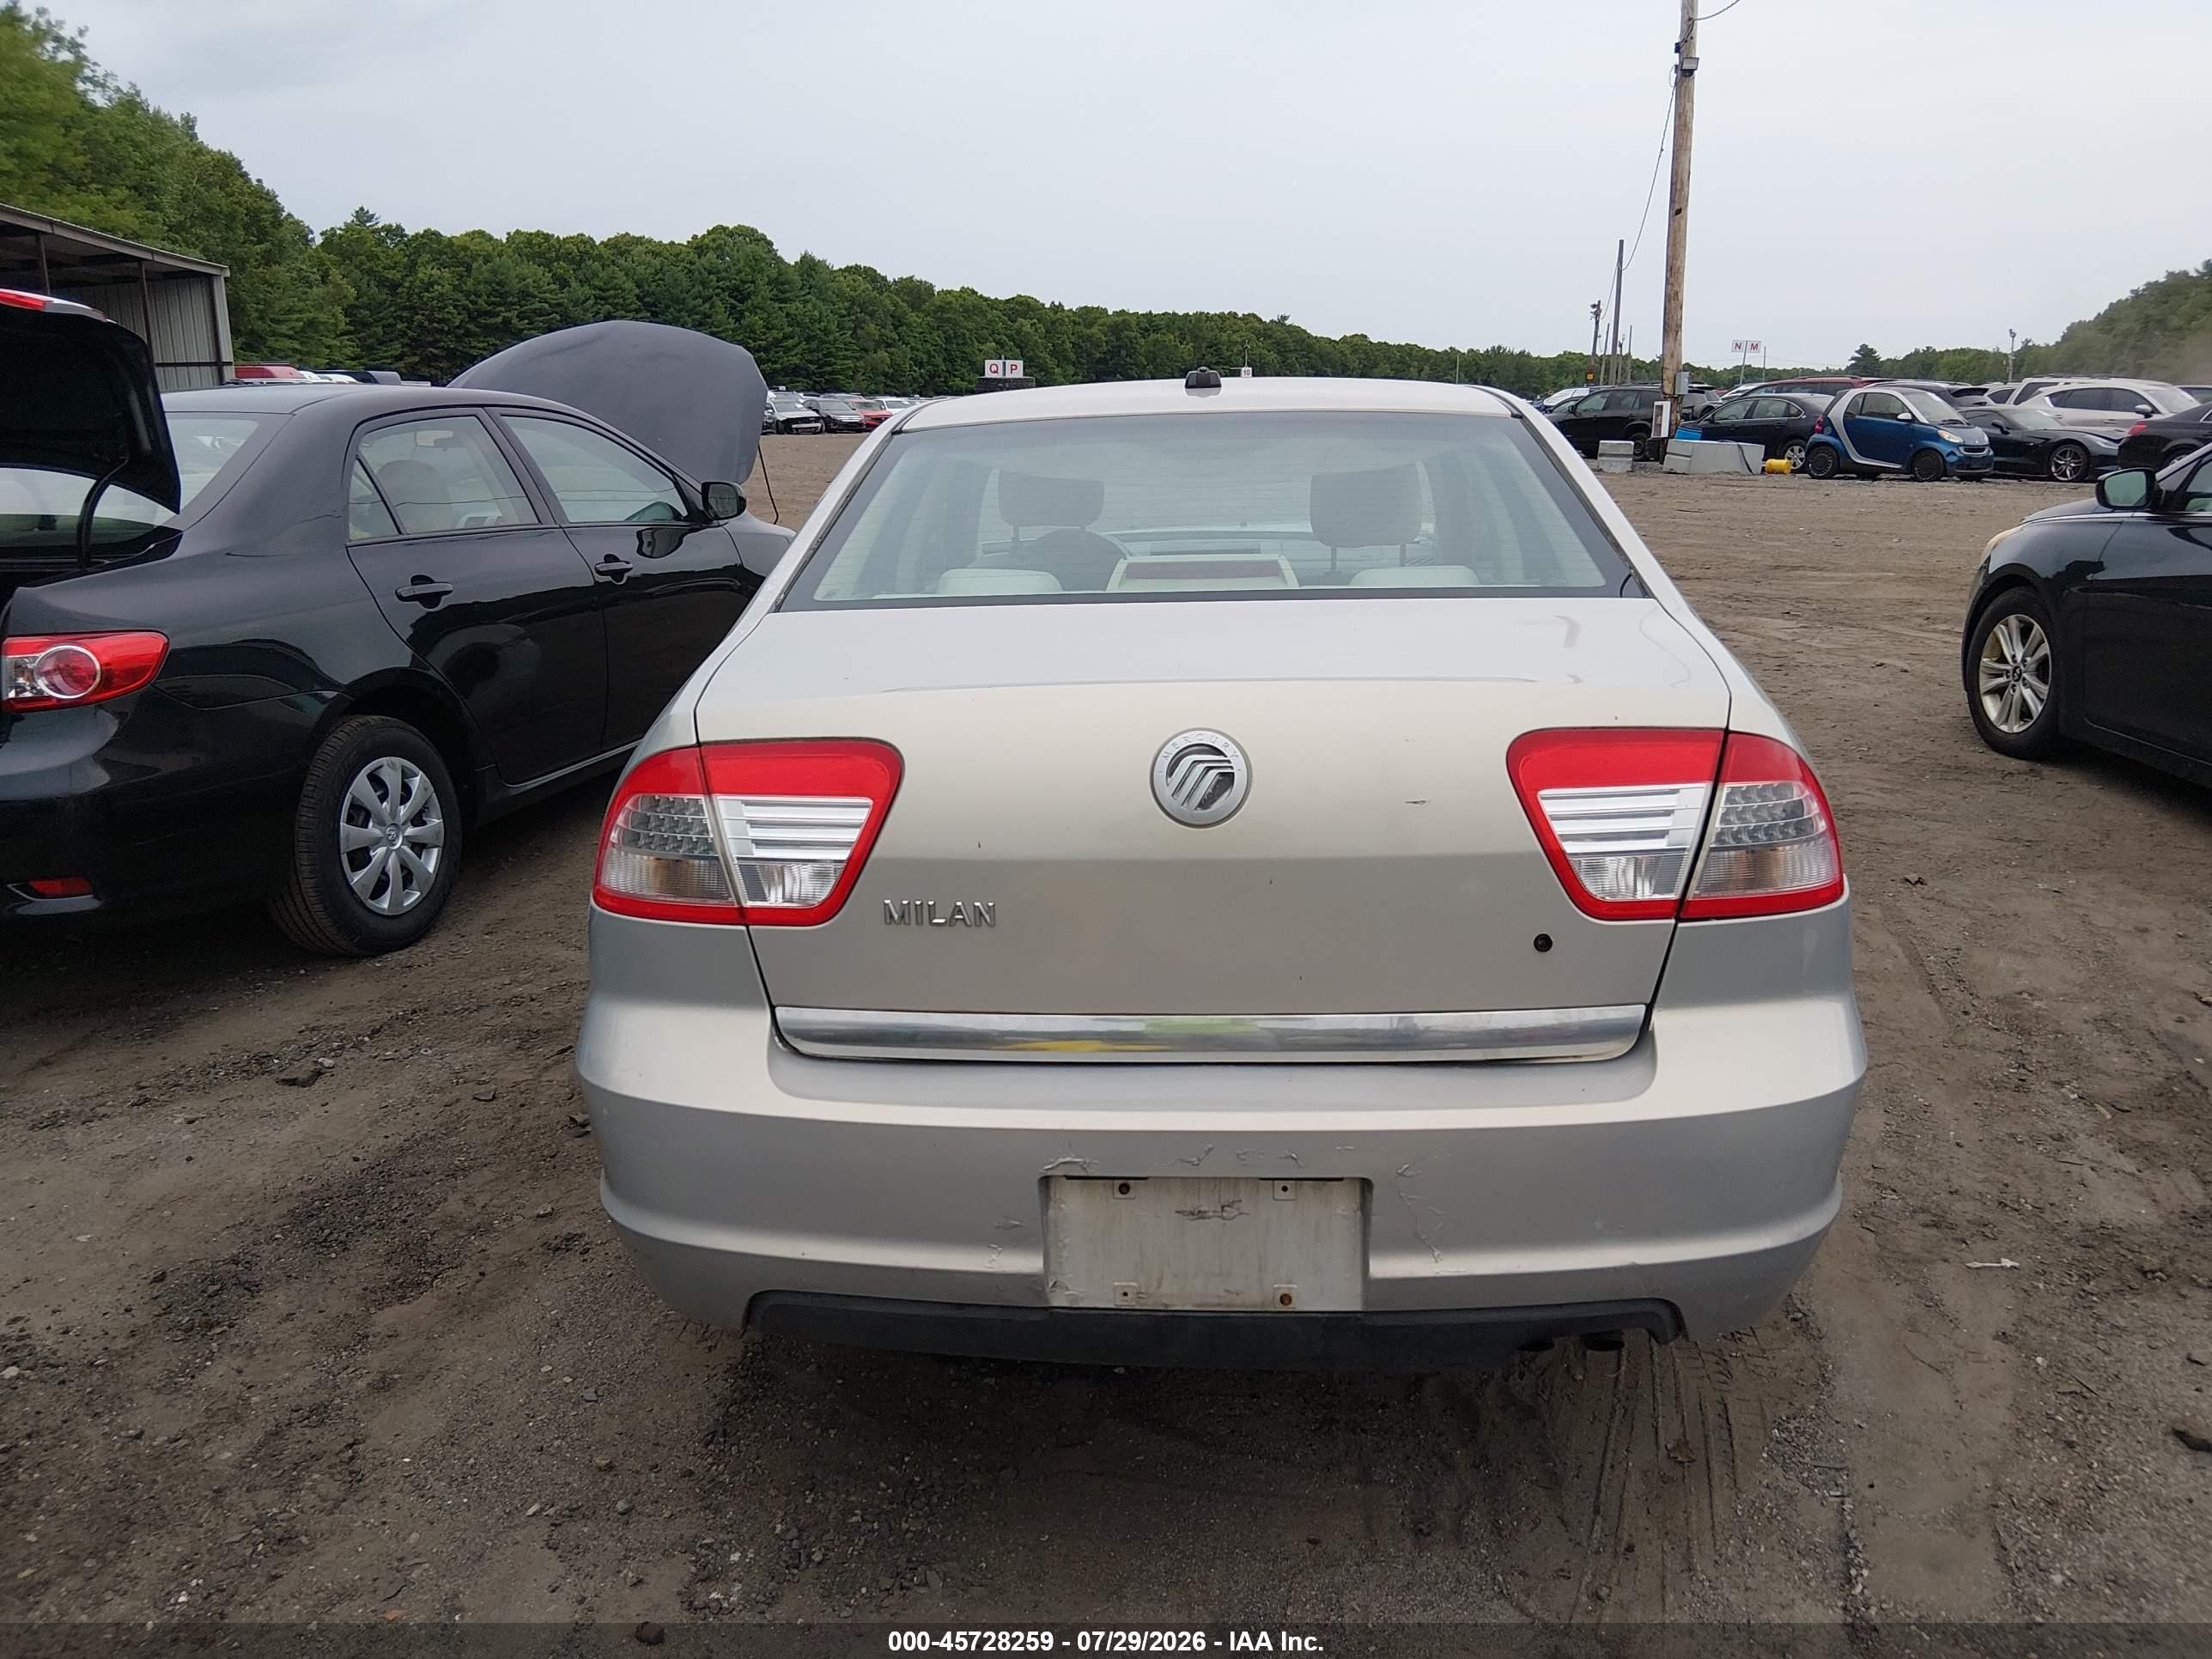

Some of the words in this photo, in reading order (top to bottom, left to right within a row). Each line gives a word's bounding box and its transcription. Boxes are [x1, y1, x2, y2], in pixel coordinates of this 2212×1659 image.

[1735, 342, 1742, 350] N
[1750, 343, 1759, 351] M
[989, 363, 1000, 374] Q
[1010, 363, 1018, 374] P
[883, 899, 996, 927] MILAN
